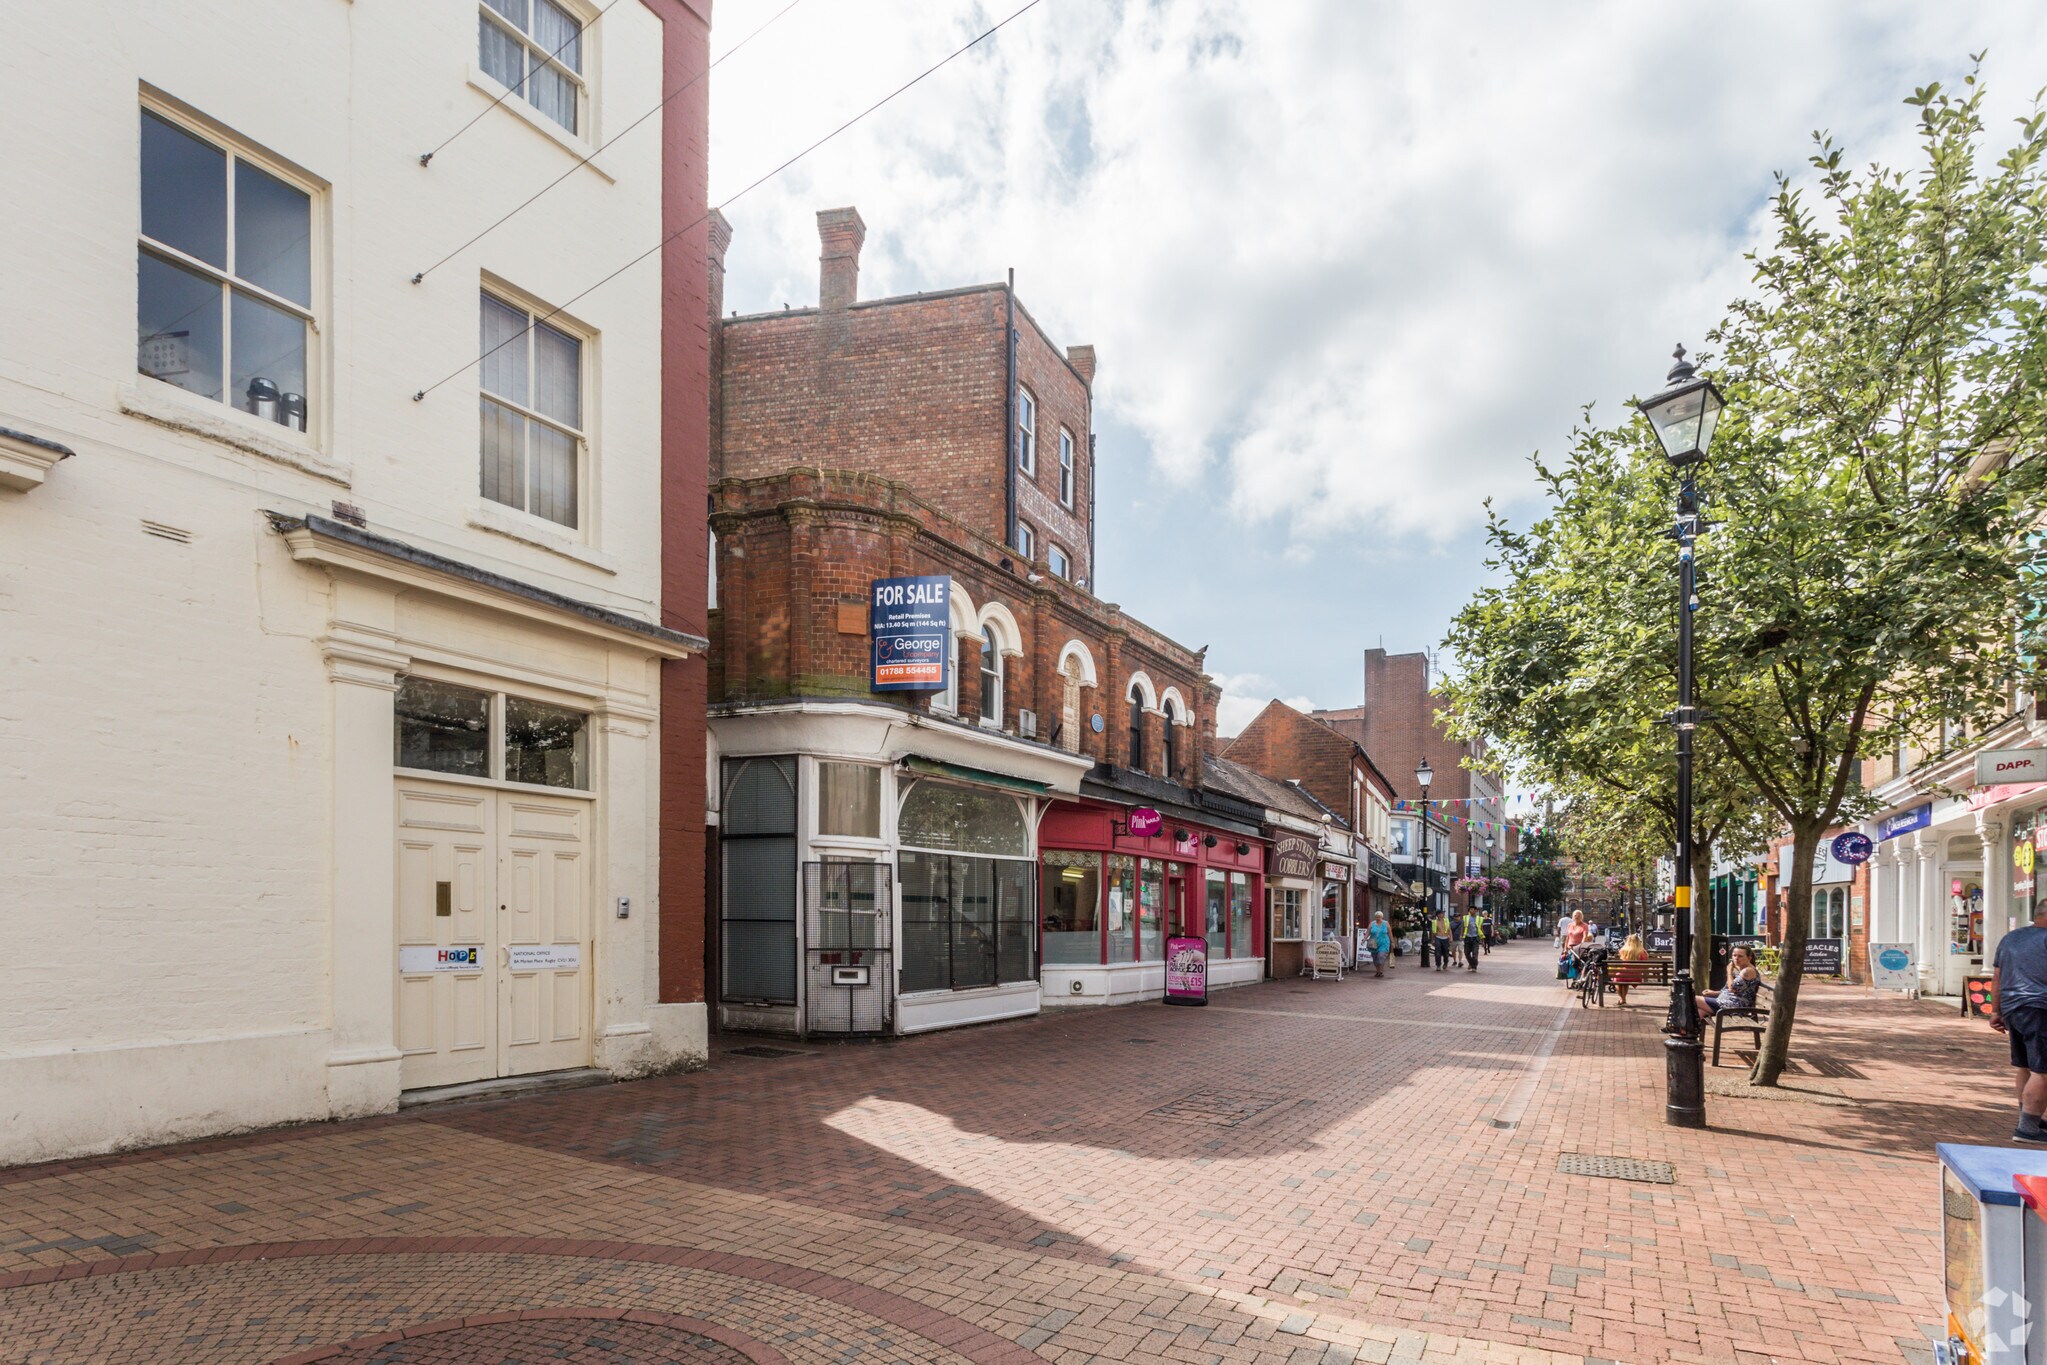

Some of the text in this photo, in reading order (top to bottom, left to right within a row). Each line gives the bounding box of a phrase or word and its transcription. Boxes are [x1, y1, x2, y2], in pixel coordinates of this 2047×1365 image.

[876, 583, 944, 607] FOR SALE
[894, 638, 940, 652] George
[906, 666, 936, 674] 554455
[1996, 760, 2031, 772] DAPP
[1132, 815, 1160, 828] Pink NAILS
[1276, 838, 1316, 862] SHEEP STREET
[1279, 858, 1310, 876] COBBLERS
[1186, 964, 1204, 973] £20
[1191, 977, 1202, 986] £15
